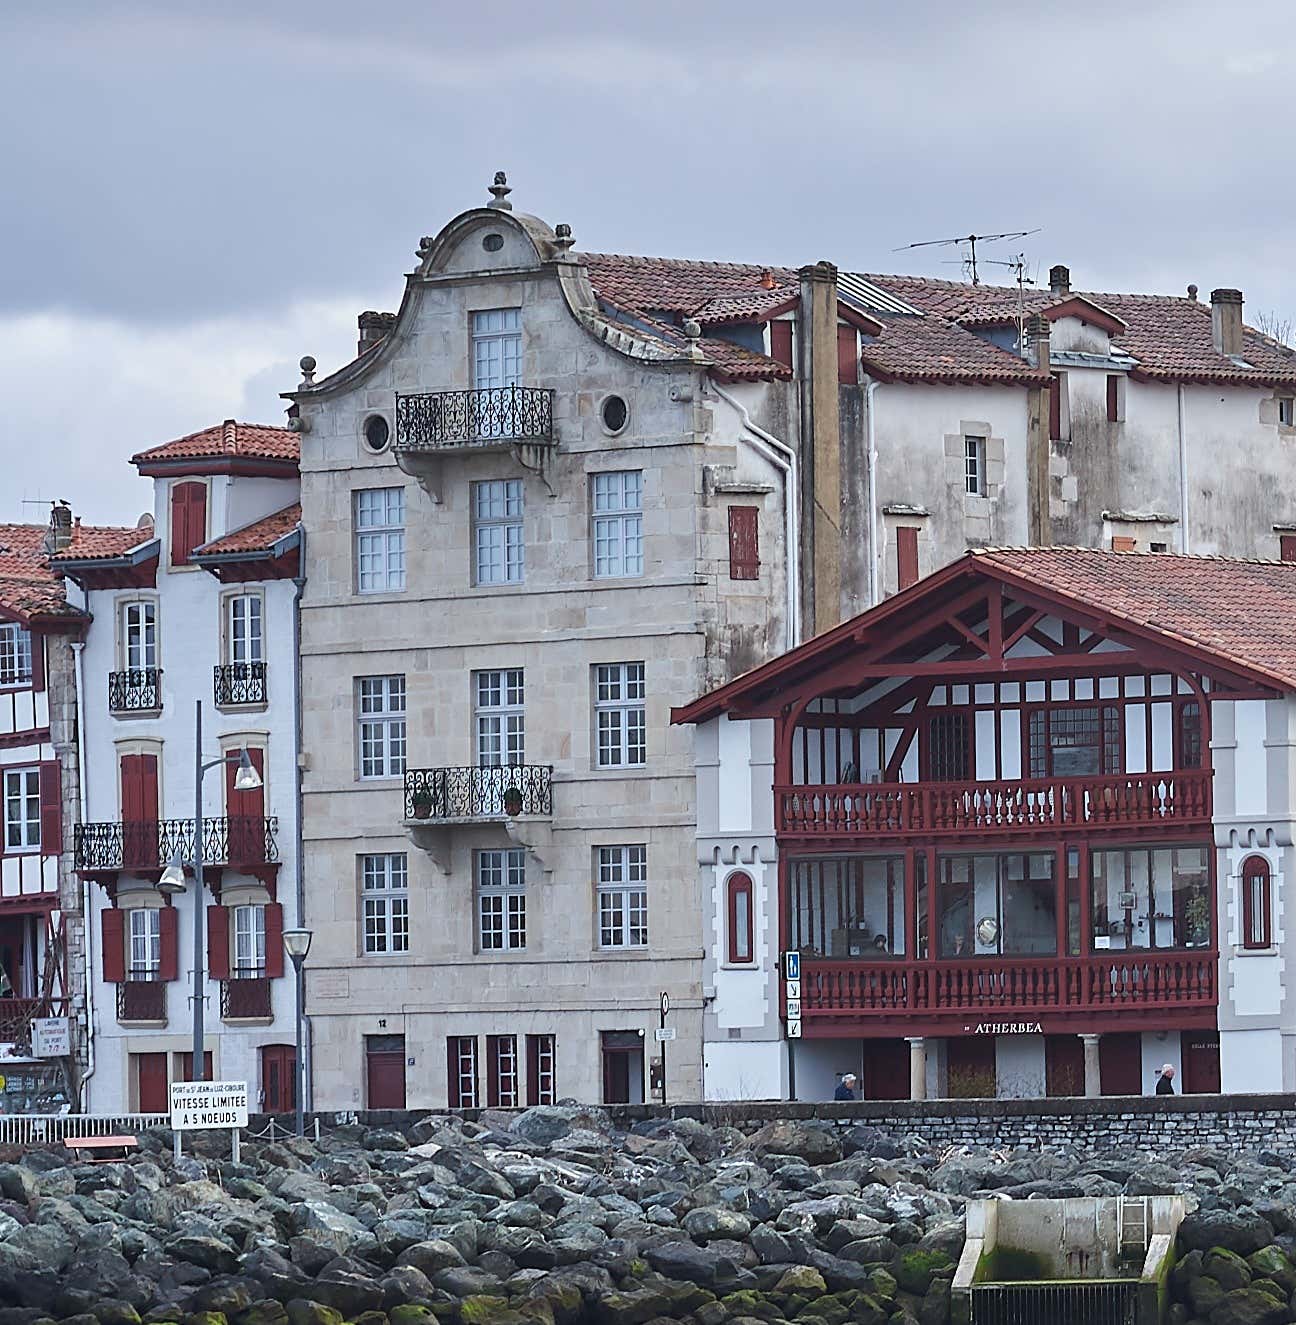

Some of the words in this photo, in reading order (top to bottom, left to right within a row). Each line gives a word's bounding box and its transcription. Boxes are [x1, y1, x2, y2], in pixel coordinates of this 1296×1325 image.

[378, 1019, 386, 1027] 12
[974, 1022, 1043, 1034] ATHERBEA
[172, 1086, 186, 1094] PORT
[173, 1097, 209, 1109] VITESSE
[212, 1096, 246, 1108] LIMITEE
[183, 1113, 189, 1125] A
[192, 1113, 198, 1125] 5
[201, 1112, 237, 1124] NOEUDS
